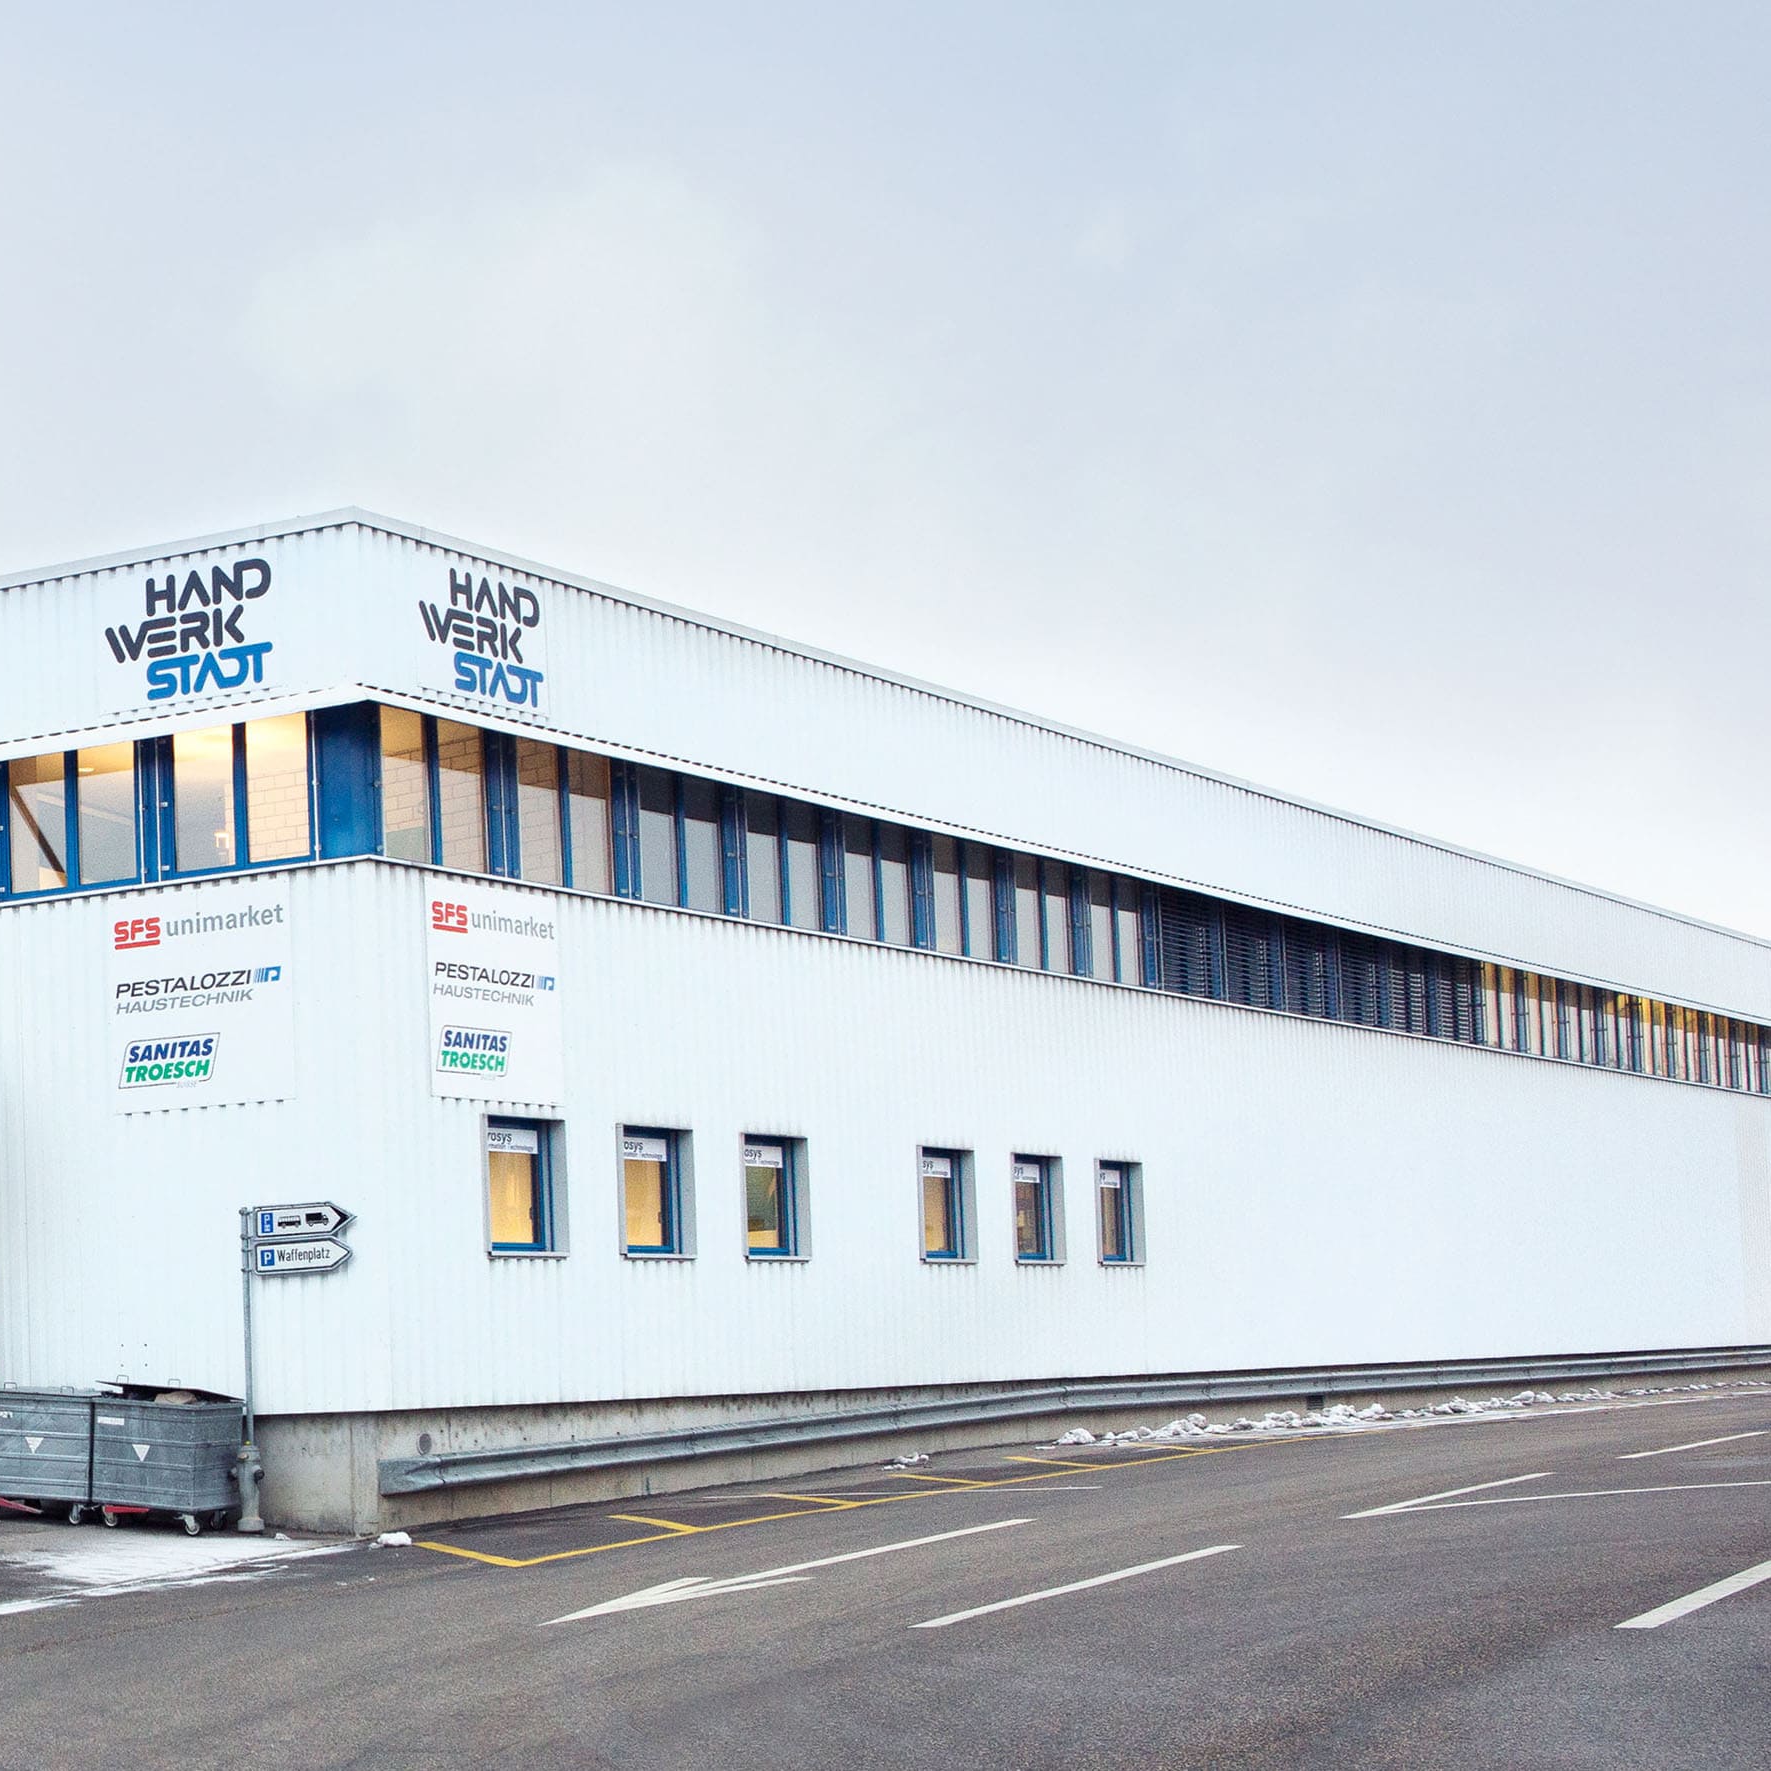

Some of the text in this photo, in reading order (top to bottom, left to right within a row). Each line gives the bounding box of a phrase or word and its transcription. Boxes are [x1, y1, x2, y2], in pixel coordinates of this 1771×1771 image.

[146, 559, 271, 616] HAND
[450, 568, 539, 627] HAND
[105, 604, 244, 663] WERK
[419, 600, 523, 664] WERK
[147, 642, 273, 700] STADT
[454, 652, 544, 707] STADT
[114, 904, 284, 943] SFS unimarket
[432, 901, 555, 940] SFS unimarket
[116, 969, 251, 999] PESTALOZZI
[435, 961, 535, 989] PESTALOZZI
[116, 988, 254, 1015] HAUSTECHNIK
[433, 983, 534, 1007] HAUSTECHNIK
[129, 1038, 214, 1063] SANITAS
[444, 1030, 507, 1052] SANITAS
[125, 1059, 210, 1083] TROESCH
[441, 1050, 505, 1072] TROESCH
[277, 1247, 331, 1263] Waffenplatz
